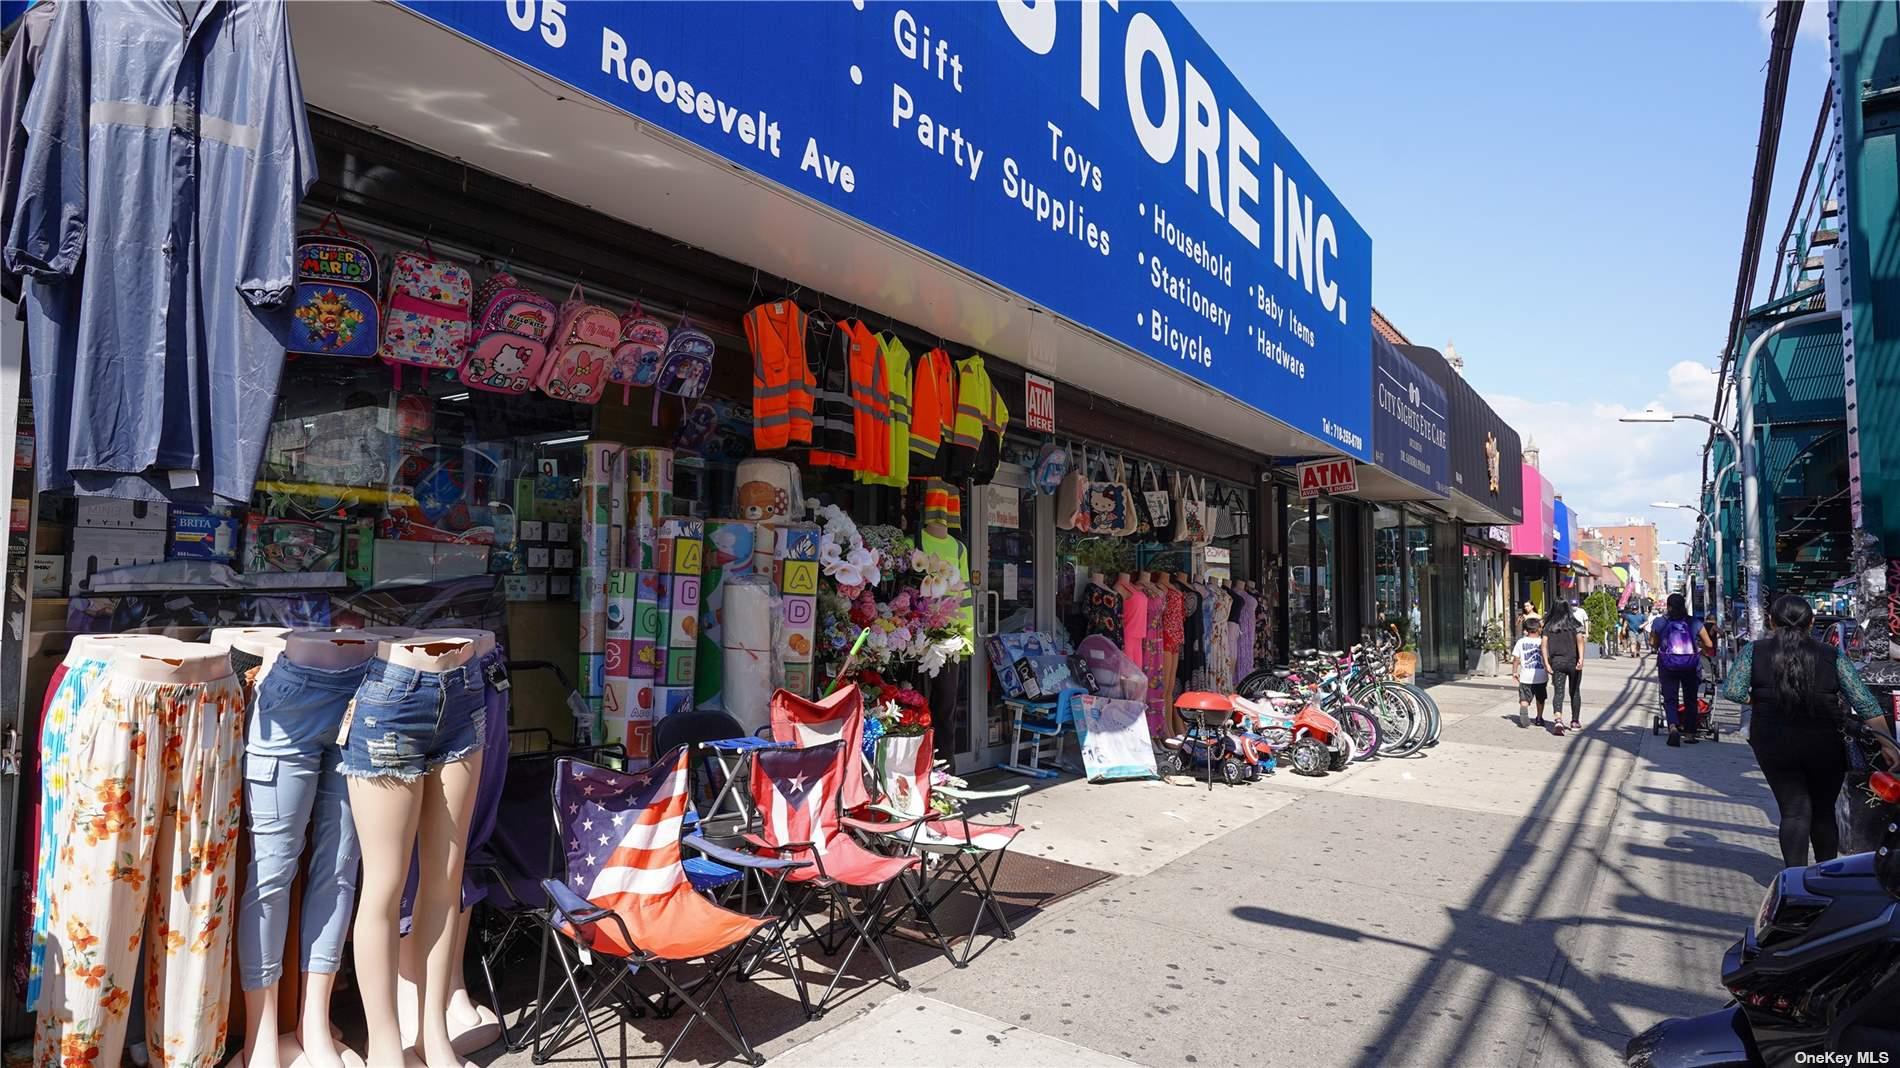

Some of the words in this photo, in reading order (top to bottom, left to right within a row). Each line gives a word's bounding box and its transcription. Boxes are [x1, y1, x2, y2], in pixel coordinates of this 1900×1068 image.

[893, 9, 963, 93] Gift
[601, 27, 781, 158] Roosevelt
[800, 137, 855, 193] Ave
[892, 83, 984, 181] Party
[1002, 157, 1110, 256] Supplies
[997, 0, 1260, 249] TORE
[1273, 162, 1347, 325] INC.
[1047, 120, 1102, 192] Toys
[303, 259, 361, 277] MARIO
[309, 249, 354, 263] SUPER
[1154, 204, 1232, 287] Household
[1150, 256, 1232, 335] Stationery
[1257, 284, 1284, 327] Baby
[1289, 309, 1315, 348] Items
[508, 313, 529, 325] HELLO
[528, 320, 548, 331] KITTY
[585, 321, 597, 337] My
[596, 325, 616, 342] Melody
[1151, 309, 1212, 368] Bicycle
[1257, 327, 1305, 379] Hardware
[1029, 385, 1053, 419] ATM
[1029, 415, 1053, 432] HERE
[1396, 396, 1420, 433] SIGHTS
[1431, 423, 1447, 450] CARE
[1303, 462, 1353, 489] ATM
[179, 517, 212, 529] BRITA
[790, 565, 813, 590] A
[788, 599, 811, 623] D
